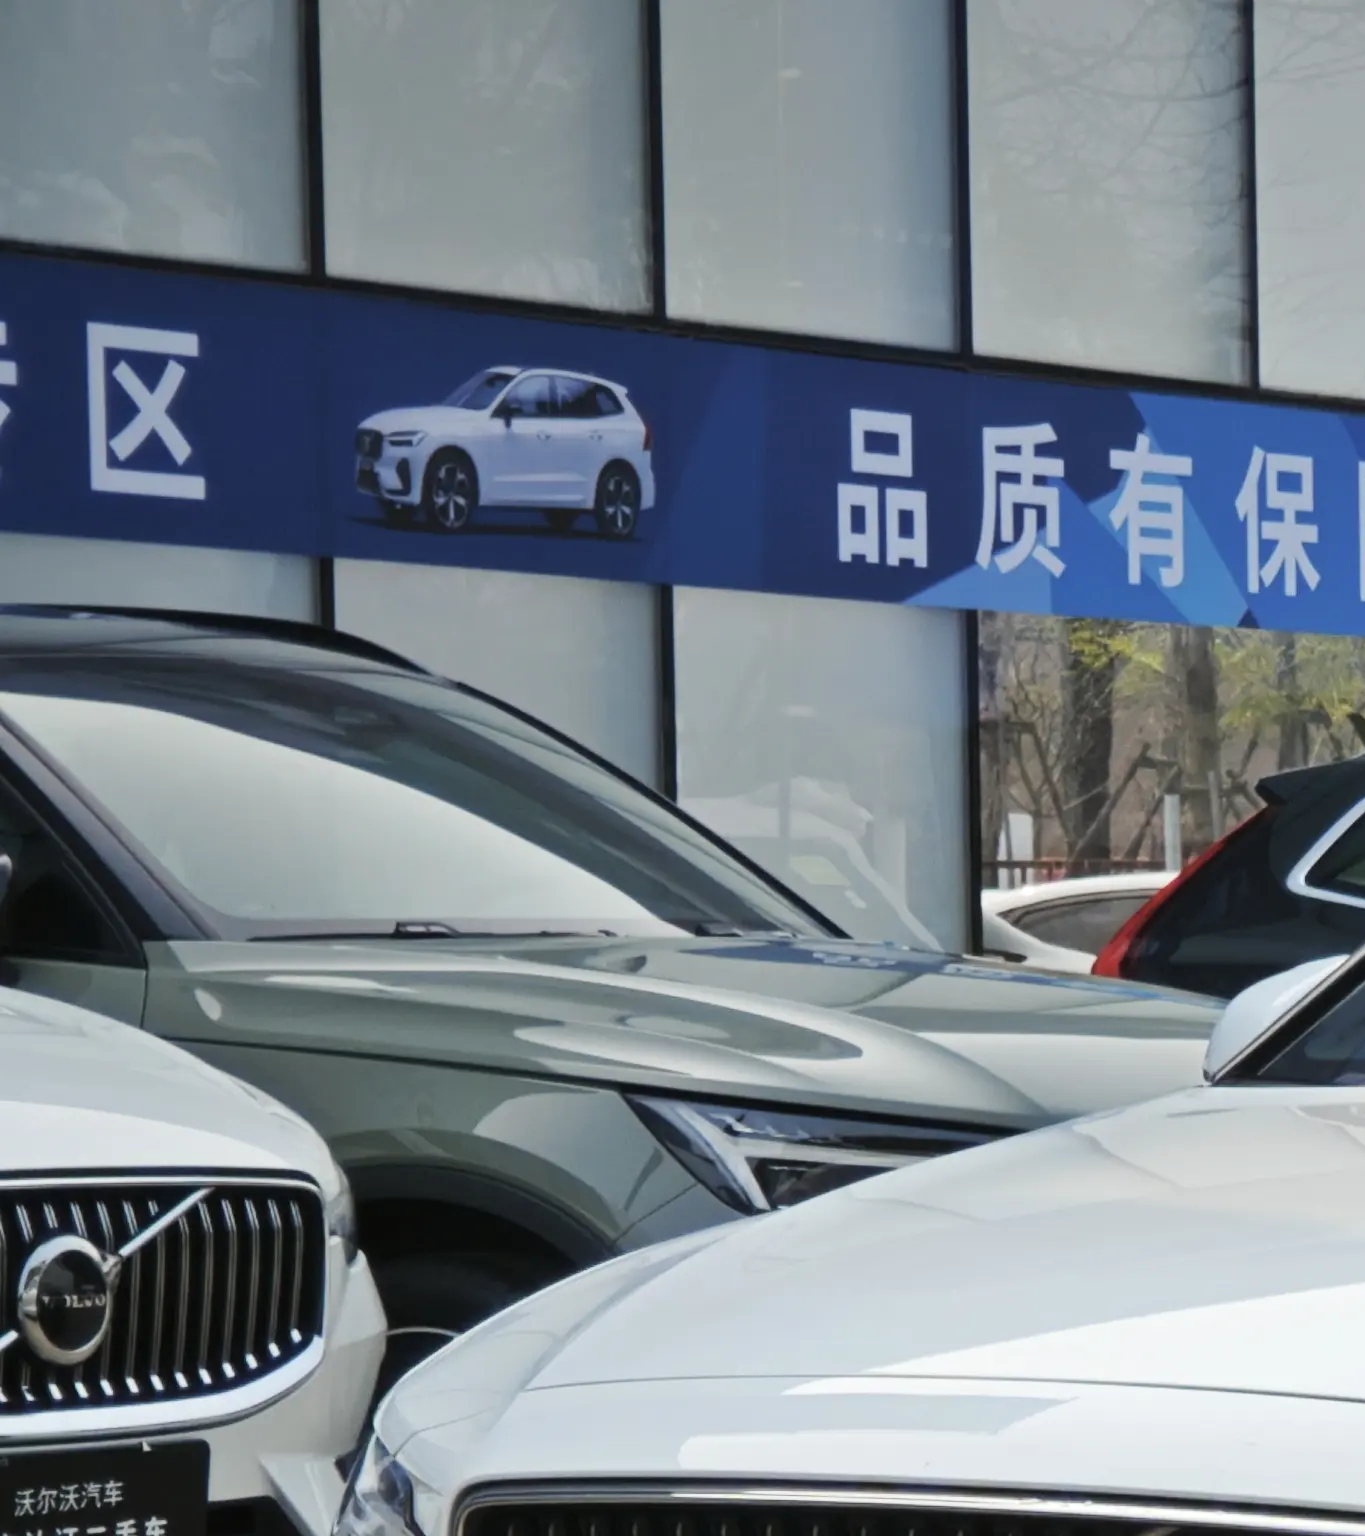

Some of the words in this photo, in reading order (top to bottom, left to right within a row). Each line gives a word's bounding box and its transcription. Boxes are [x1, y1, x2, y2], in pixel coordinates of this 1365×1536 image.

[0, 320, 206, 500] 区
[14, 1480, 124, 1517] 沃尔沃汽车
